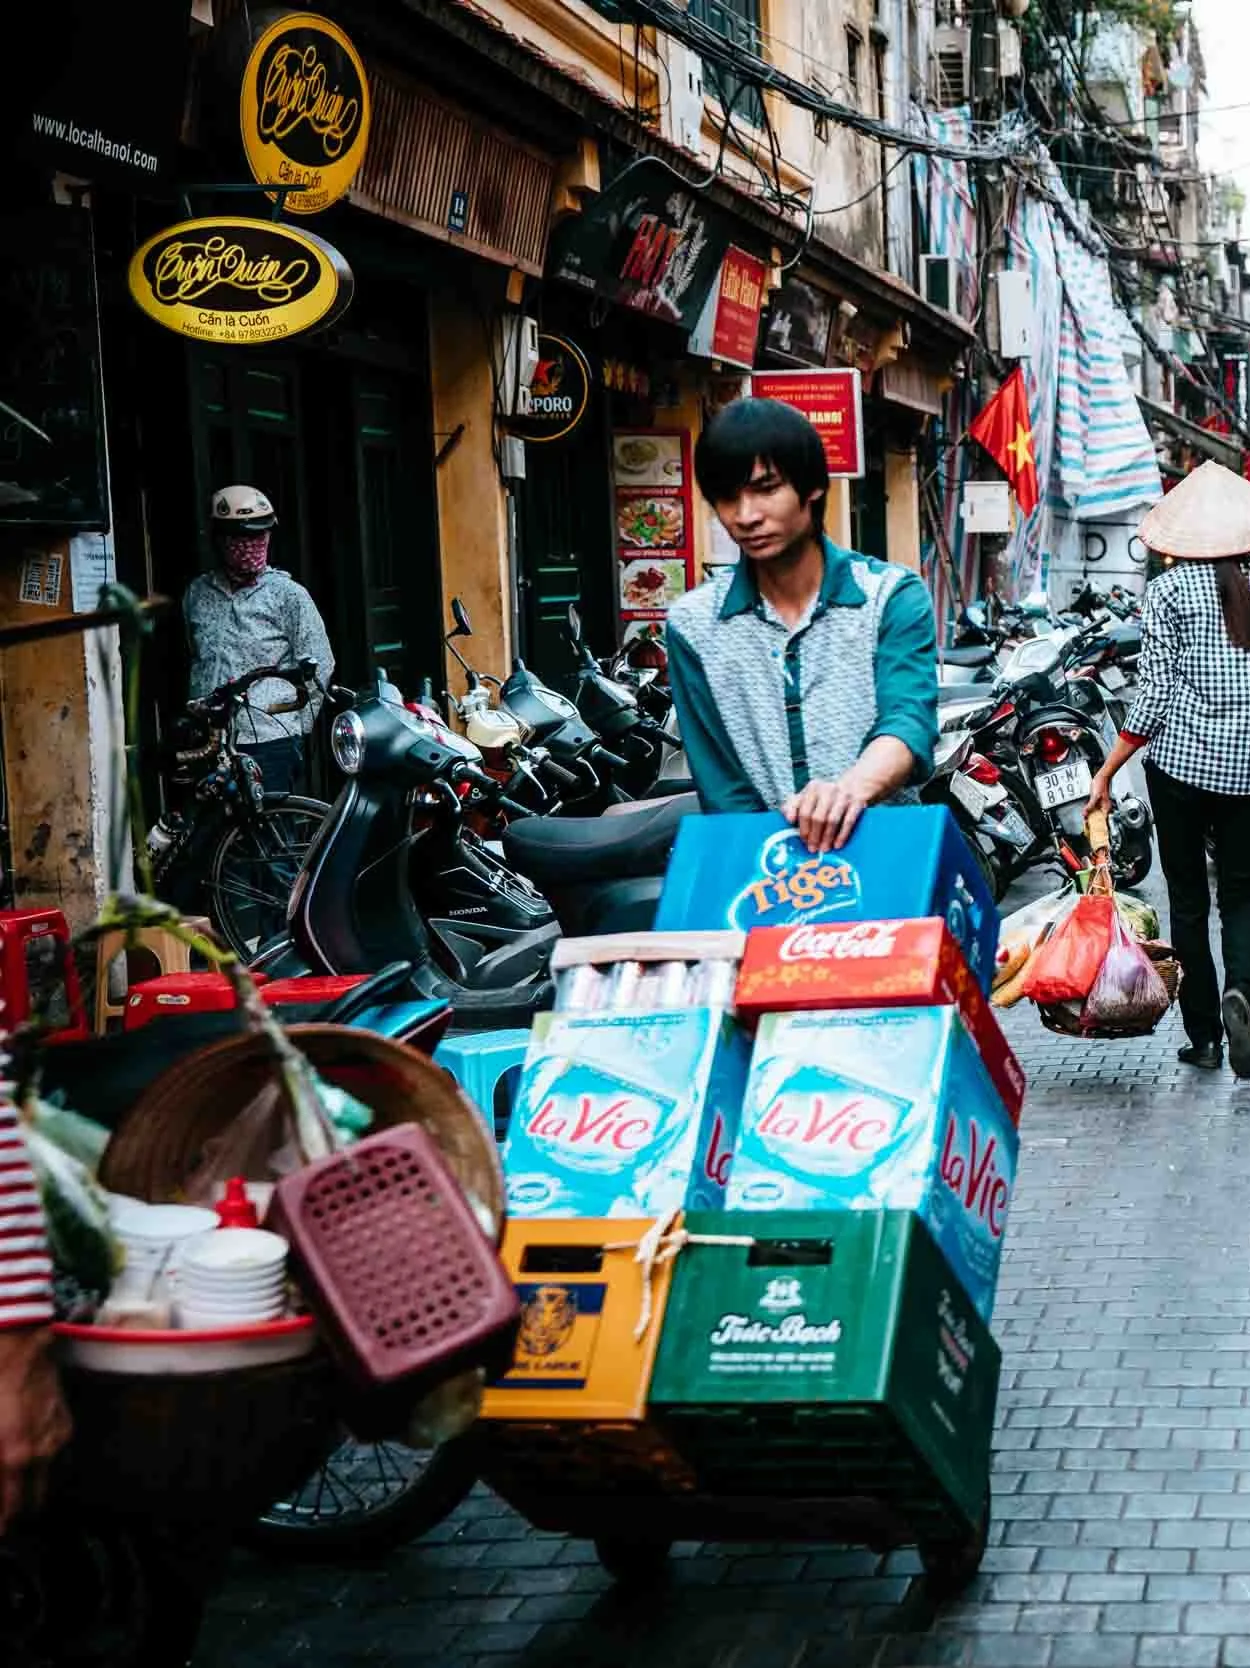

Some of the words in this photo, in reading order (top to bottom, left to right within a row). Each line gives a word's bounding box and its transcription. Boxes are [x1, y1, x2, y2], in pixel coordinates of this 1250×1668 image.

[33, 112, 158, 173] www.localhanoi.com
[225, 315, 236, 327] là
[750, 858, 854, 915] Tiger
[448, 906, 489, 917] HONDA
[779, 921, 904, 962] Coca-Cola
